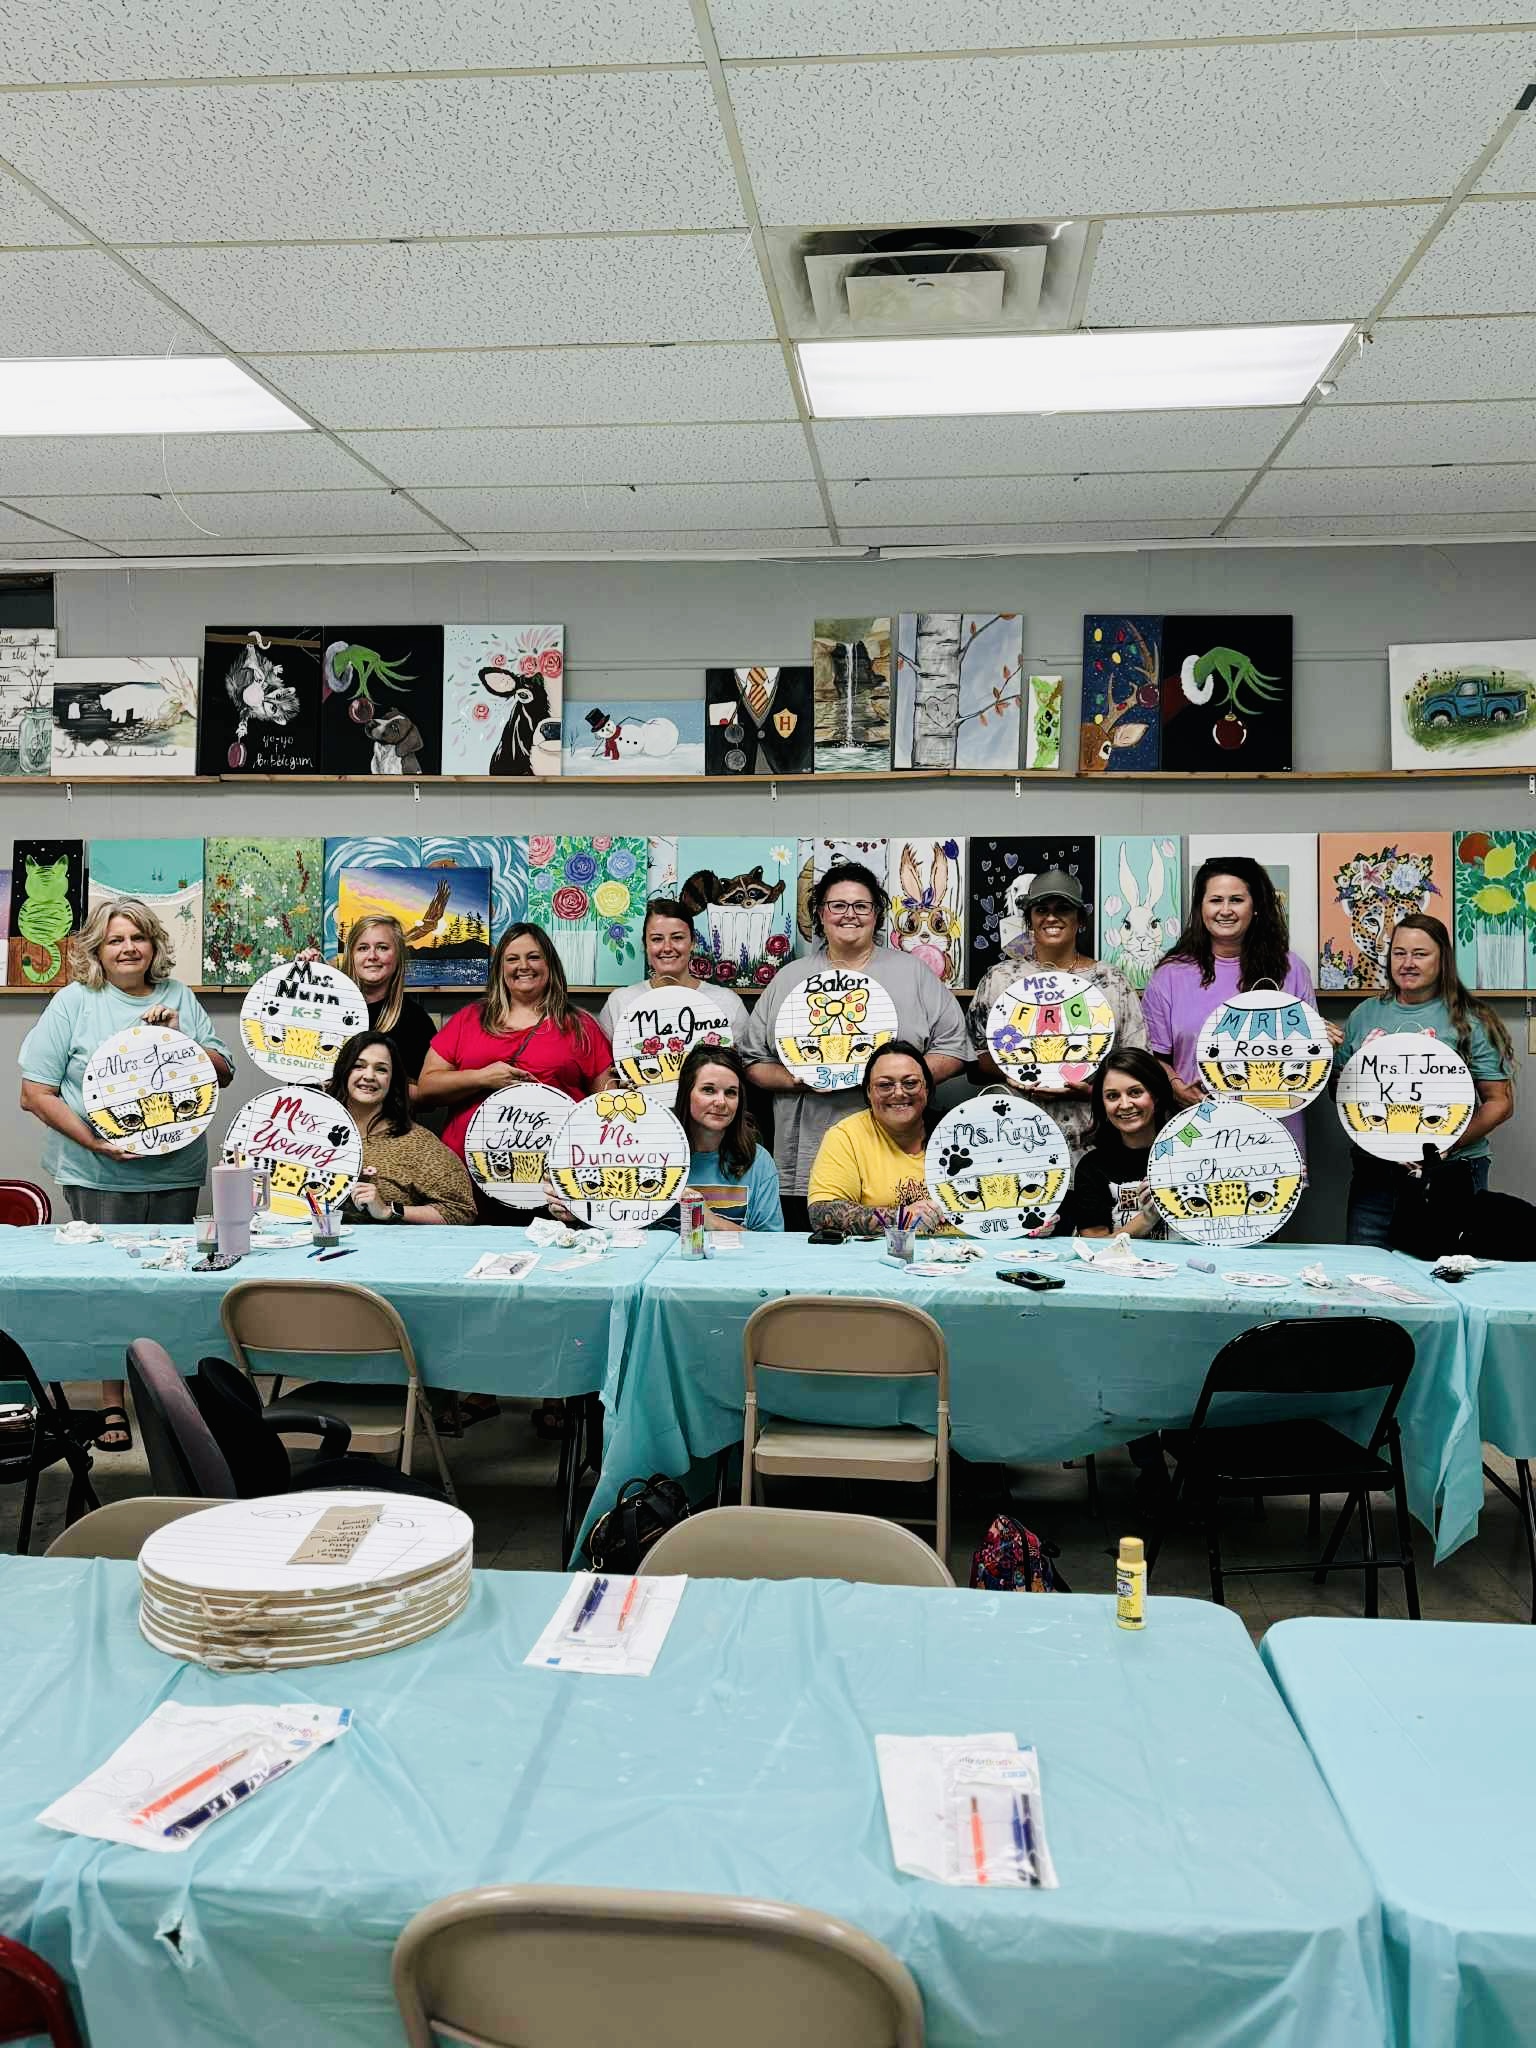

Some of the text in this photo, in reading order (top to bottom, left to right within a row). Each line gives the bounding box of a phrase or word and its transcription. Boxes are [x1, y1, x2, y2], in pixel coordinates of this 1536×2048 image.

[778, 716, 792, 731] H
[276, 979, 340, 1006] Nunn
[804, 970, 869, 993] Baker
[1023, 976, 1058, 991] Mrs
[291, 1006, 322, 1020] K-5
[1222, 1009, 1301, 1030] MRS
[678, 1006, 729, 1044] Jones
[1234, 1040, 1294, 1057] Rose
[143, 1043, 197, 1090] Jones
[1420, 1053, 1466, 1074] Jones
[814, 1064, 859, 1089] 3rd
[248, 1120, 349, 1168] Young
[599, 1124, 640, 1148] Ms.
[571, 1144, 670, 1167] Dunaway
[609, 1200, 659, 1221] Grade
[1199, 1225, 1261, 1240] STUDENTS
